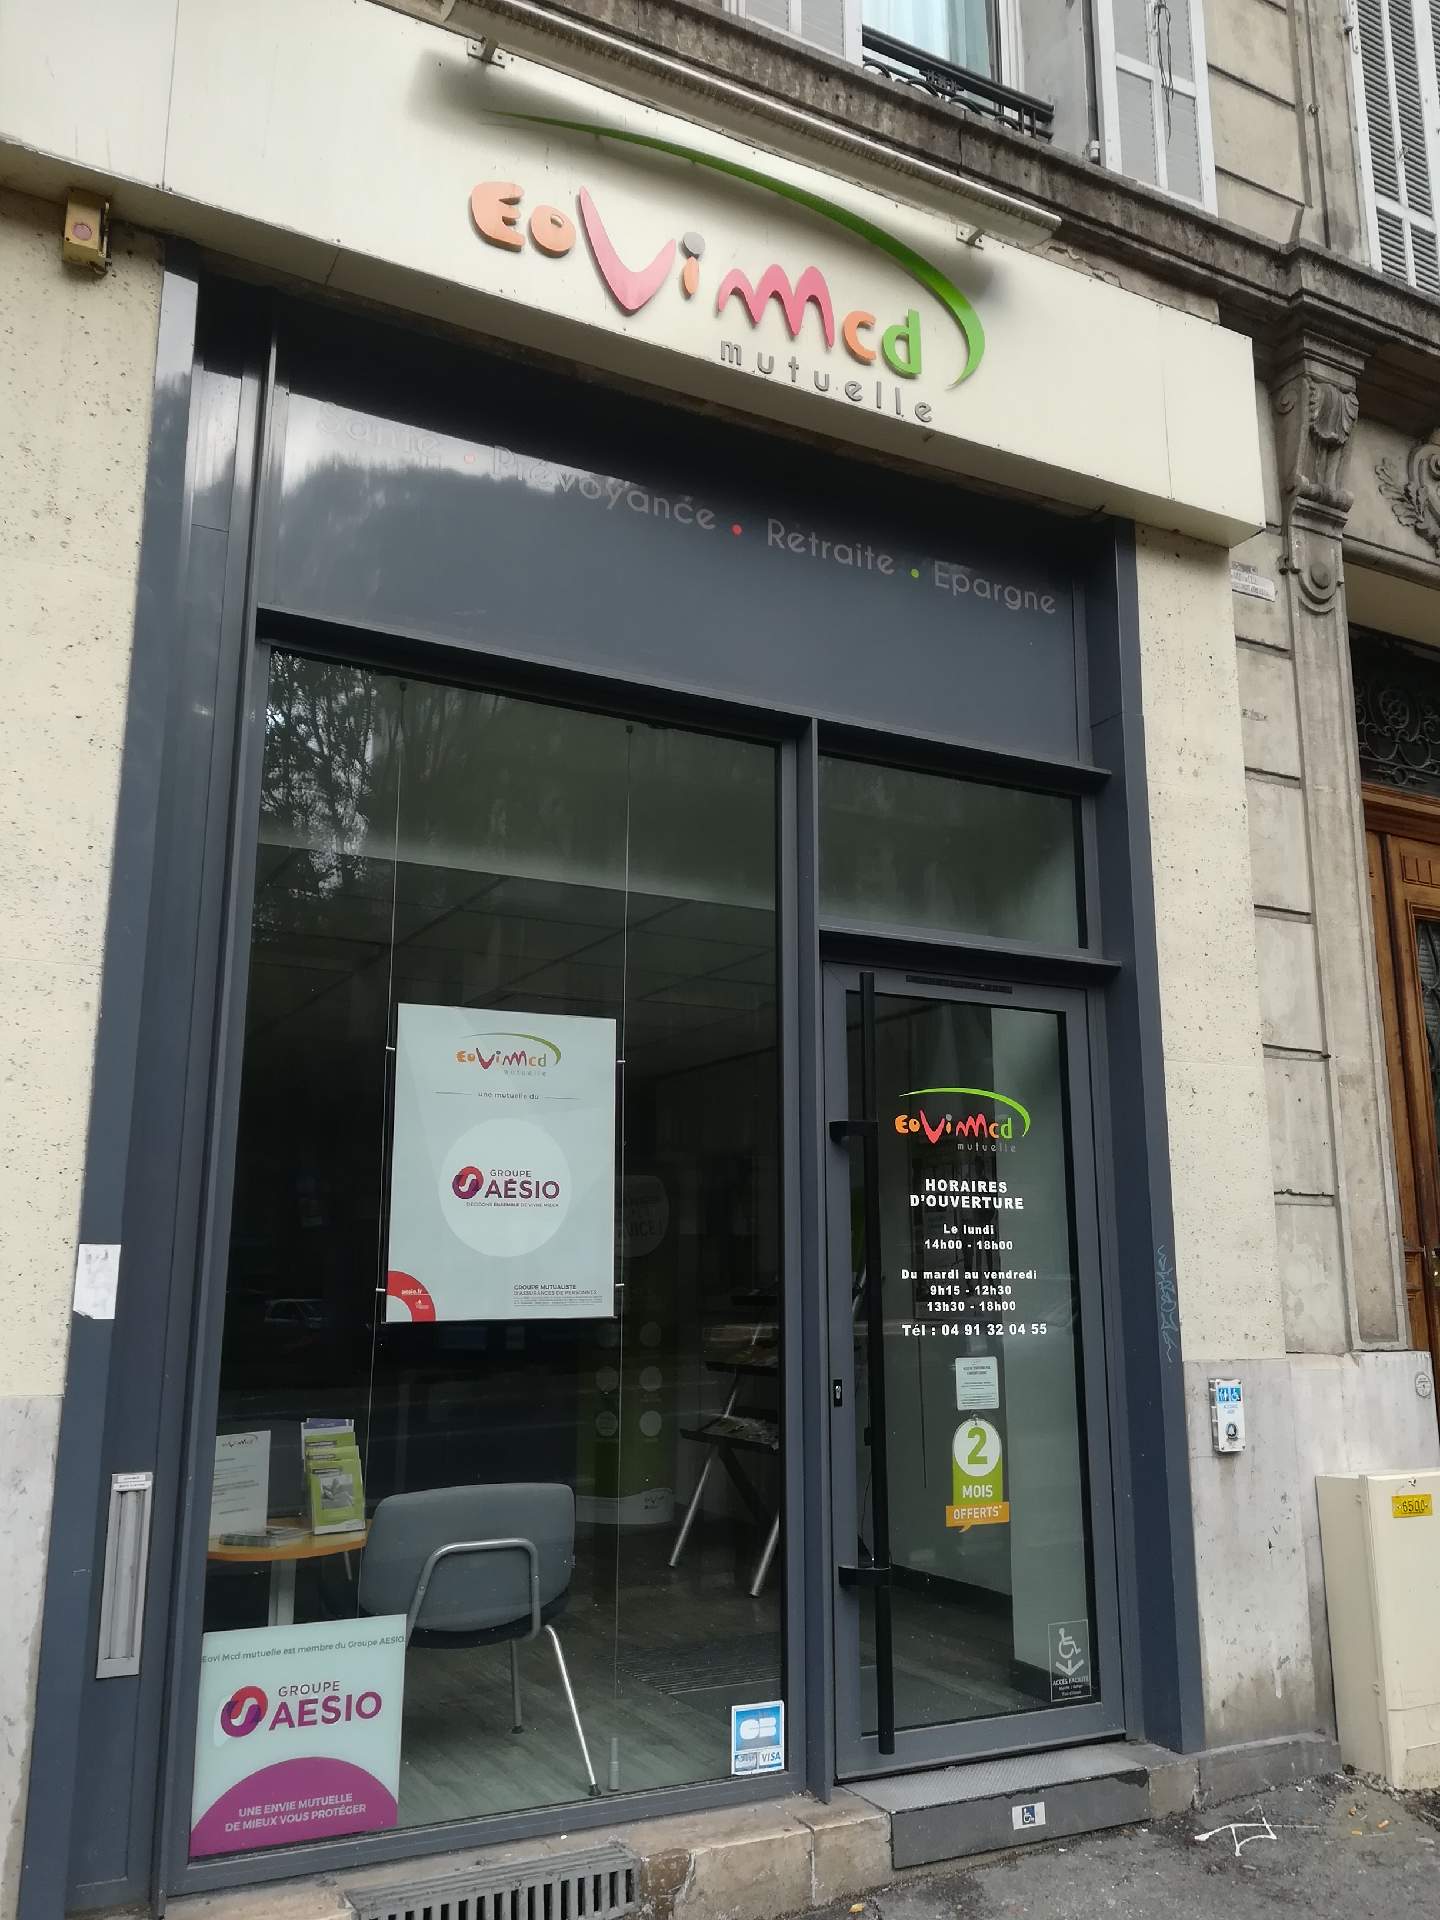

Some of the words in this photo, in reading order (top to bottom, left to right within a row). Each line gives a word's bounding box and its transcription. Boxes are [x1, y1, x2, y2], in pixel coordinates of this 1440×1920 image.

[721, 340, 933, 423] mutuelle
[494, 445, 716, 530] Prévoyance
[768, 518, 895, 575] Retraite
[934, 560, 1056, 614] Epargne
[529, 1092, 539, 1100] du
[957, 1141, 1017, 1152] mutuelle
[490, 1169, 532, 1177] GROUPE
[485, 1178, 560, 1199] AÉSIO
[925, 1178, 1008, 1194] HORAIRES
[910, 1195, 1024, 1210] D'OUVERTURE
[943, 1224, 958, 1235] Le
[963, 1224, 995, 1235] lundi
[924, 1240, 963, 1251] 14h00
[976, 1240, 1013, 1251] 18h00
[901, 1269, 918, 1280] Du
[923, 1269, 959, 1280] mardi
[964, 1271, 979, 1280] au
[983, 1269, 1037, 1280] vendredi
[930, 1285, 961, 1296] 9h15
[974, 1285, 1013, 1296] 12h30
[927, 1301, 966, 1312] 13h30
[979, 1301, 1017, 1312] 18h00
[902, 1324, 926, 1337] Tél
[941, 1325, 960, 1336] 04
[964, 1324, 981, 1336] 91
[987, 1324, 1005, 1336] 32
[1009, 1324, 1027, 1336] 04
[1031, 1323, 1048, 1335] 55
[967, 1427, 988, 1464] 2
[962, 1484, 993, 1498] MOIS
[242, 1649, 281, 1660] mutuelle
[283, 1647, 296, 1655] est
[297, 1643, 334, 1654] membre
[335, 1641, 346, 1650] du
[347, 1639, 378, 1651] Groupe
[278, 1680, 341, 1697] GROUPE
[268, 1691, 382, 1731] AESIO
[762, 1751, 781, 1762] VISA
[238, 1805, 262, 1818] UNE
[264, 1802, 297, 1814] ENVIE
[298, 1793, 353, 1809] MUTUELLE
[225, 1821, 240, 1832] DE
[243, 1817, 277, 1830] MIEUX
[279, 1812, 310, 1825] VOUS
